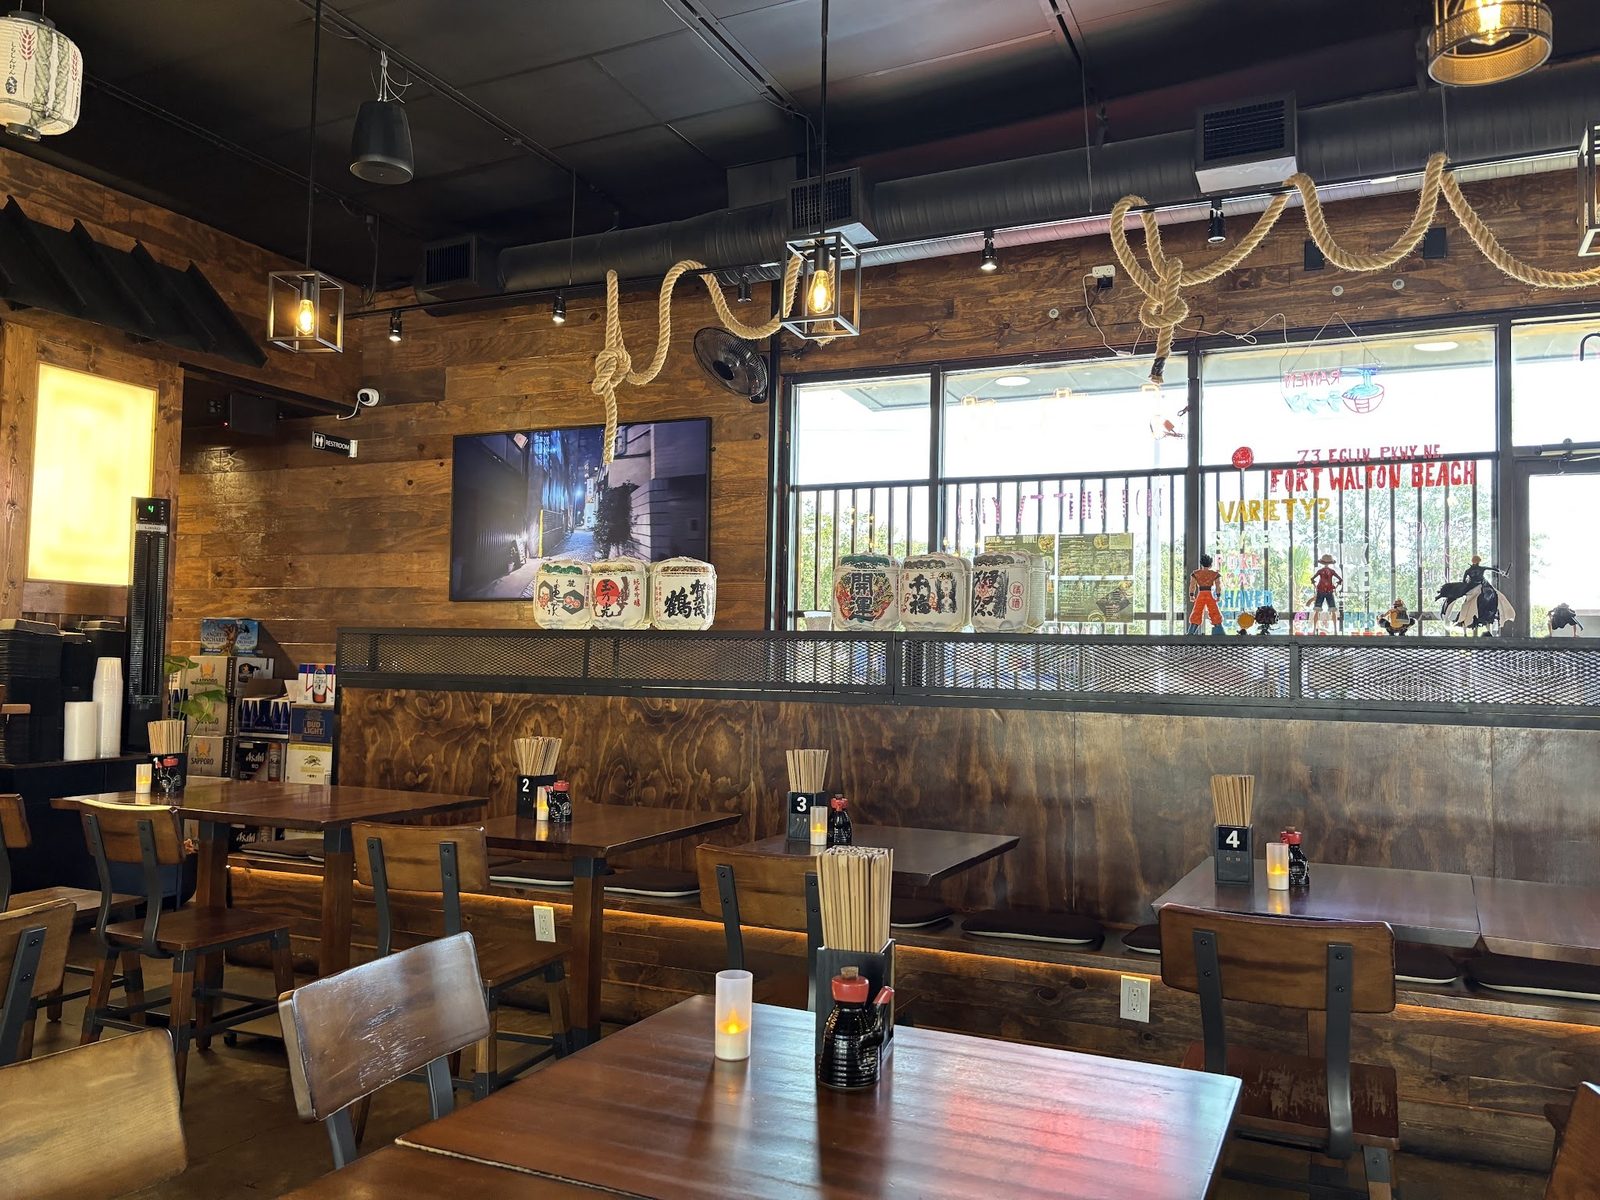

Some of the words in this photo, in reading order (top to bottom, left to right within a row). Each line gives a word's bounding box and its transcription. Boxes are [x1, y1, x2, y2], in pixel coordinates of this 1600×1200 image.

[325, 439, 350, 450] RESTROOM
[1297, 448, 1321, 466] 73
[1380, 444, 1418, 461] PKWY
[1270, 466, 1323, 492] FORT
[1329, 464, 1401, 491] WALTON
[1412, 460, 1476, 489] BEACH
[1218, 497, 1330, 523] VARIETY?
[304, 727, 324, 735] LIGHT
[190, 757, 214, 765] SAPPORO
[522, 777, 530, 793] 2
[796, 796, 807, 812] 3
[1225, 830, 1241, 848] 4
